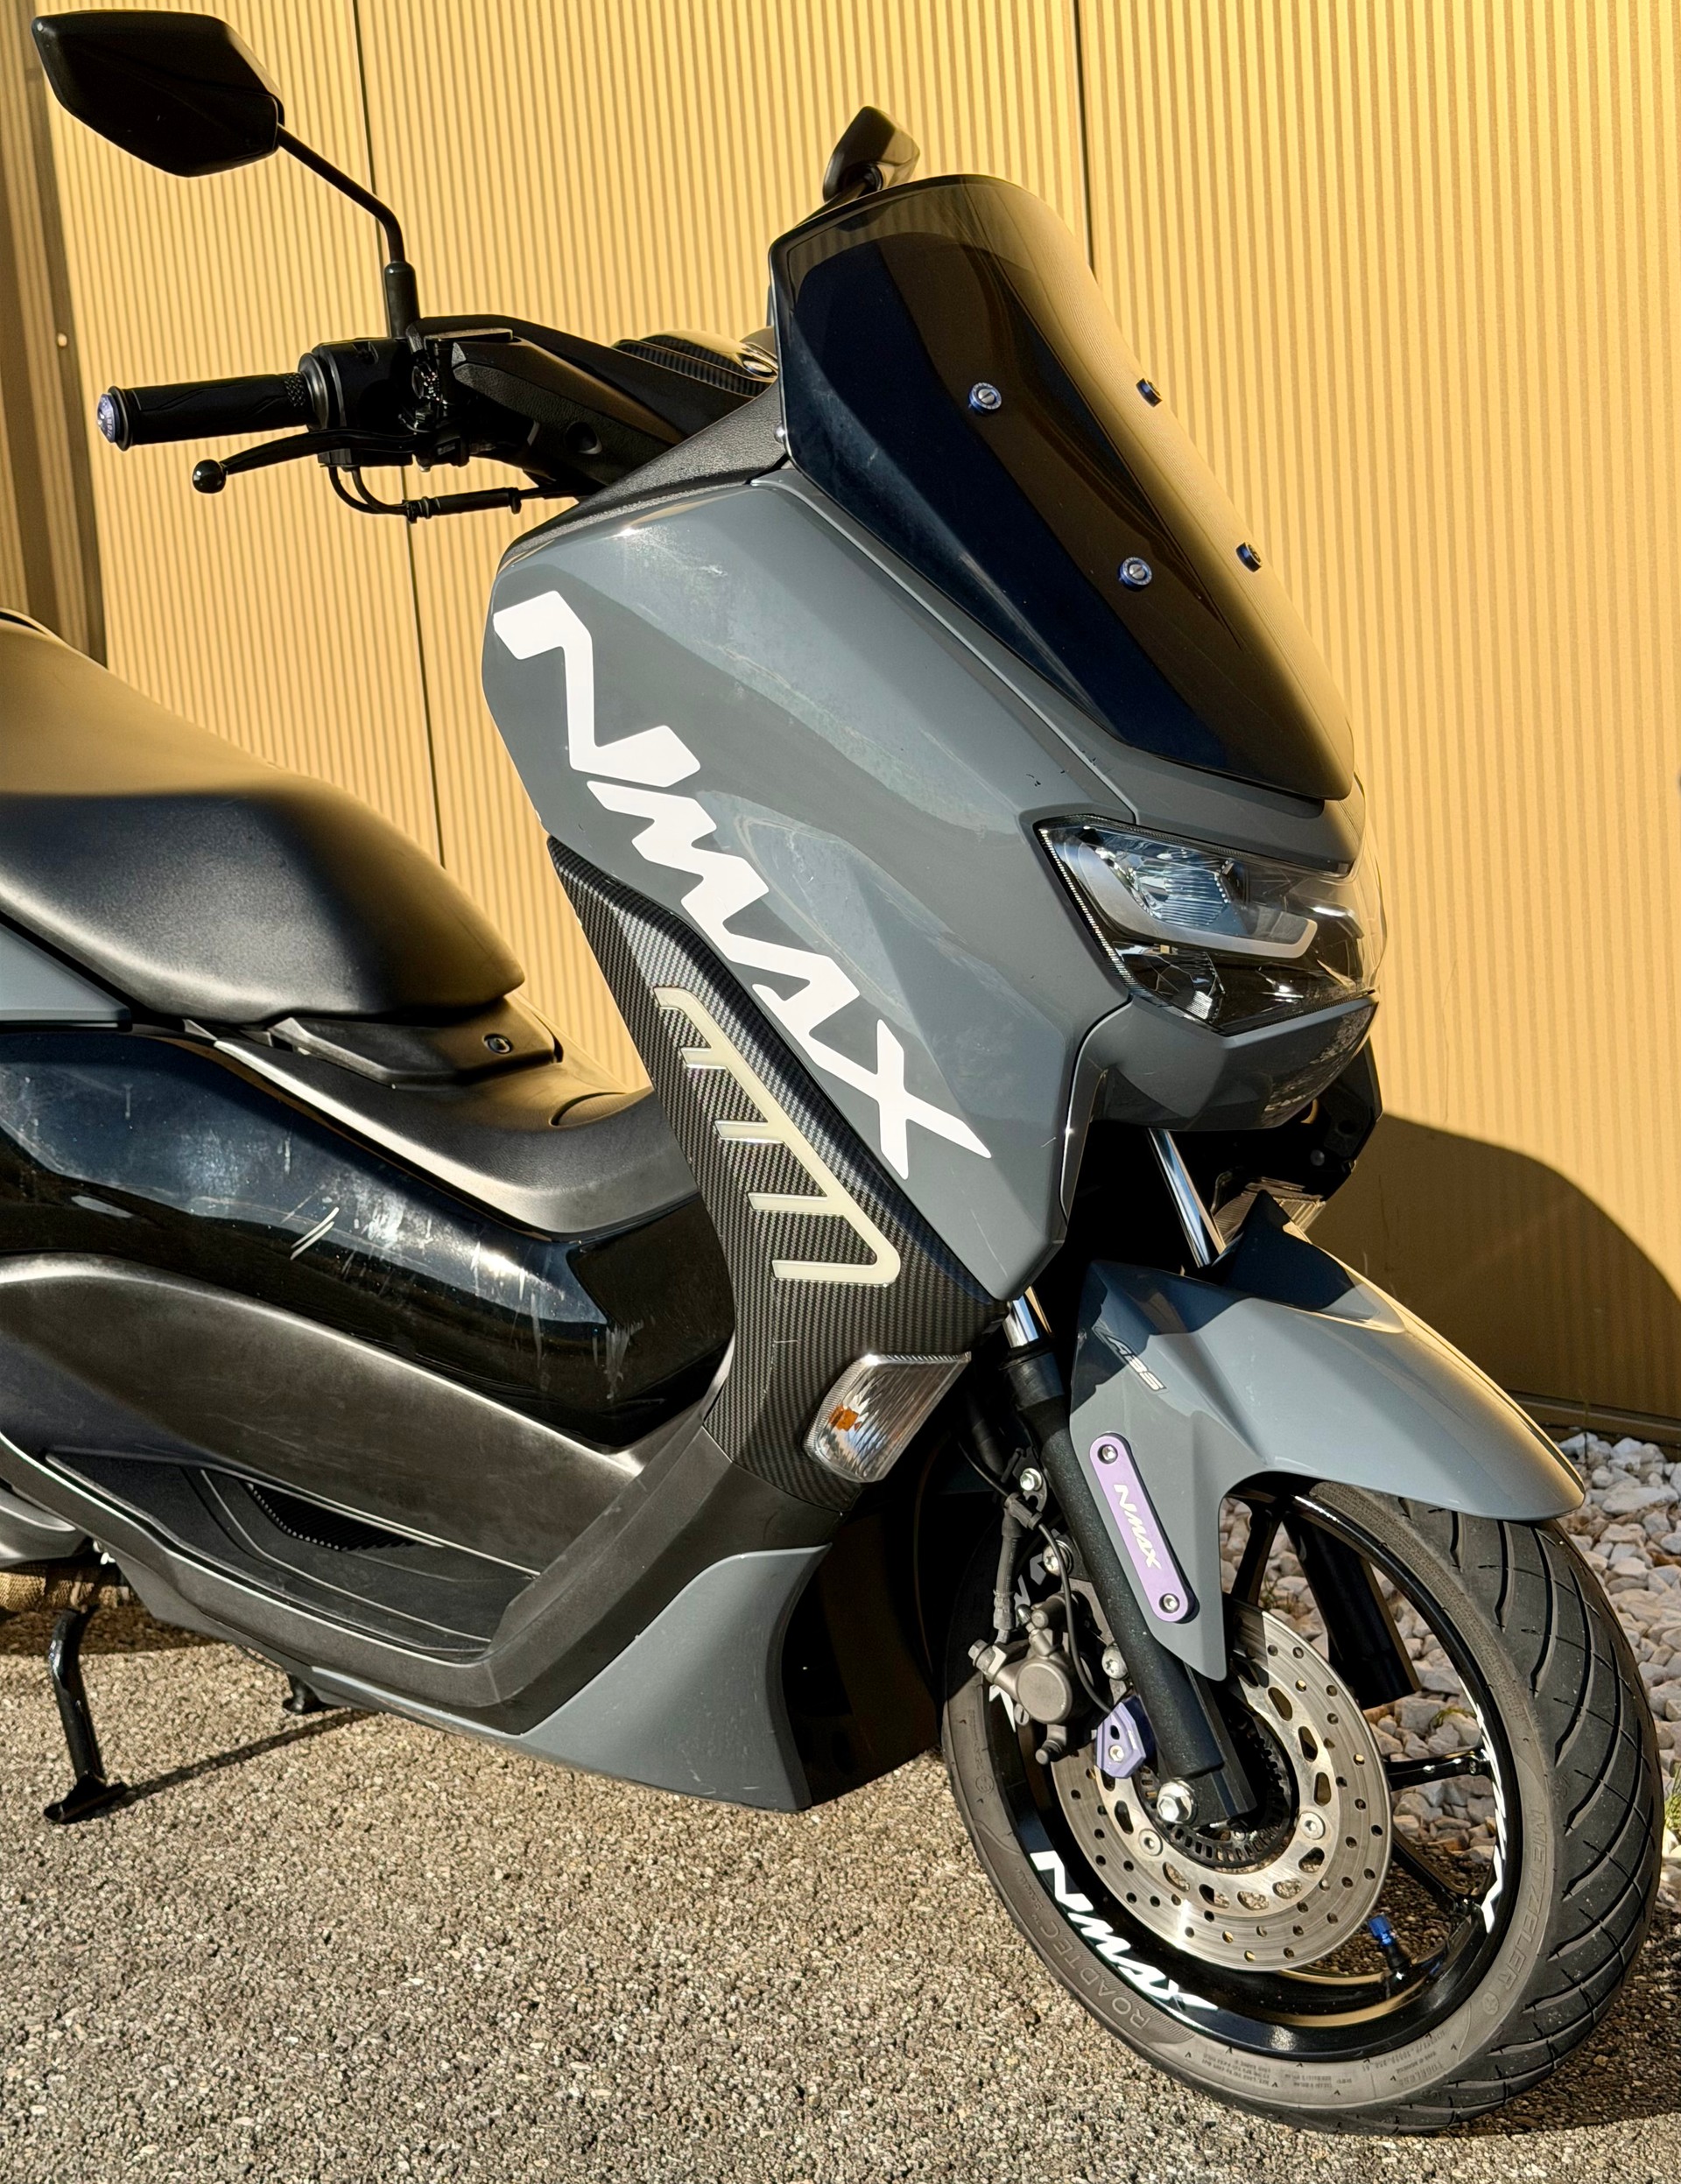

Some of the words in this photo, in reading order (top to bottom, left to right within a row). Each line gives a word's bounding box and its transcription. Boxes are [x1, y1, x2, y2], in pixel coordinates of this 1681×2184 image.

[493, 590, 992, 1180] NMAX
[1104, 1334, 1166, 1391] ABS
[1113, 1483, 1162, 1571] NMAX
[1029, 1850, 1219, 2012] NMAX
[1498, 1809, 1548, 1991] METZELER
